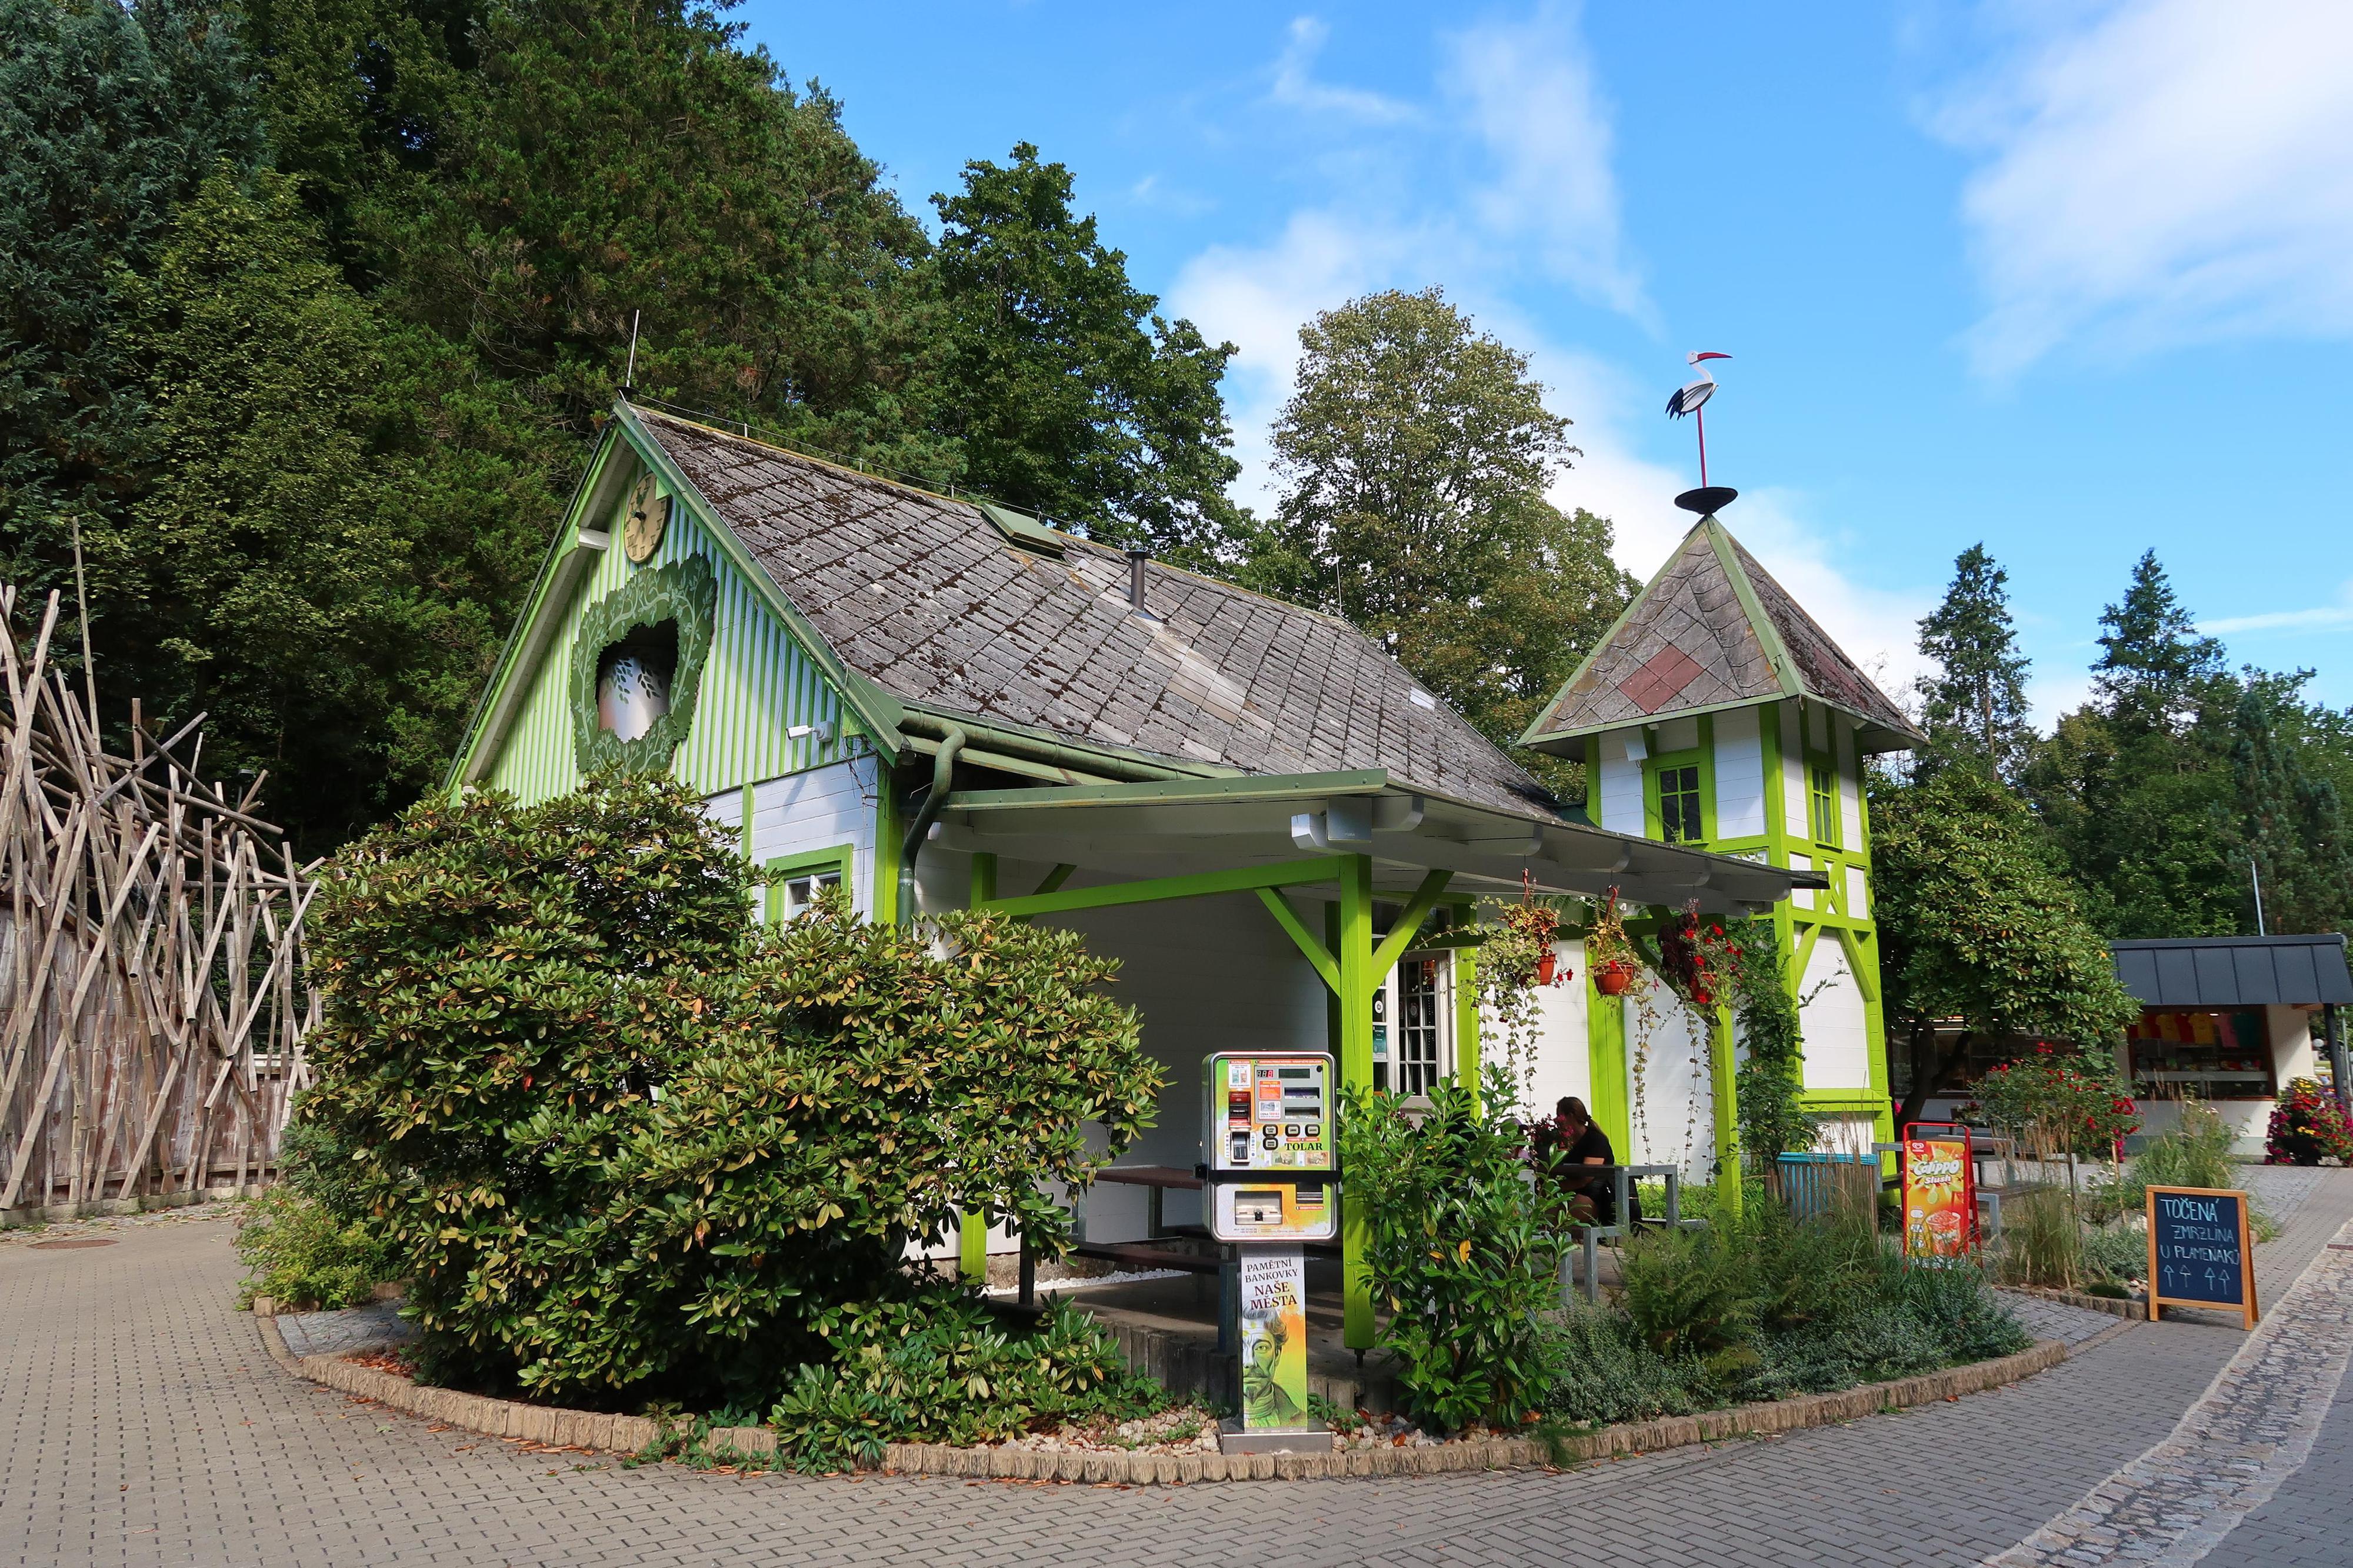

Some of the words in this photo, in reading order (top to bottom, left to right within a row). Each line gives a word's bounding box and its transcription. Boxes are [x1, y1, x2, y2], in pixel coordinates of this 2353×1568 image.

[1285, 1142, 1323, 1150] TOLAR
[1913, 1160, 1960, 1176] Calippo
[1924, 1175, 1952, 1185] Slush
[2160, 1197, 2219, 1222] TOČENÁ
[2160, 1245, 2170, 1259] U
[1247, 1257, 1292, 1272] PAMĚTNÍ
[1245, 1268, 1298, 1283] BANKOVKY
[1254, 1280, 1289, 1296] NAŠE
[1251, 1295, 1298, 1310] MĚSTA
